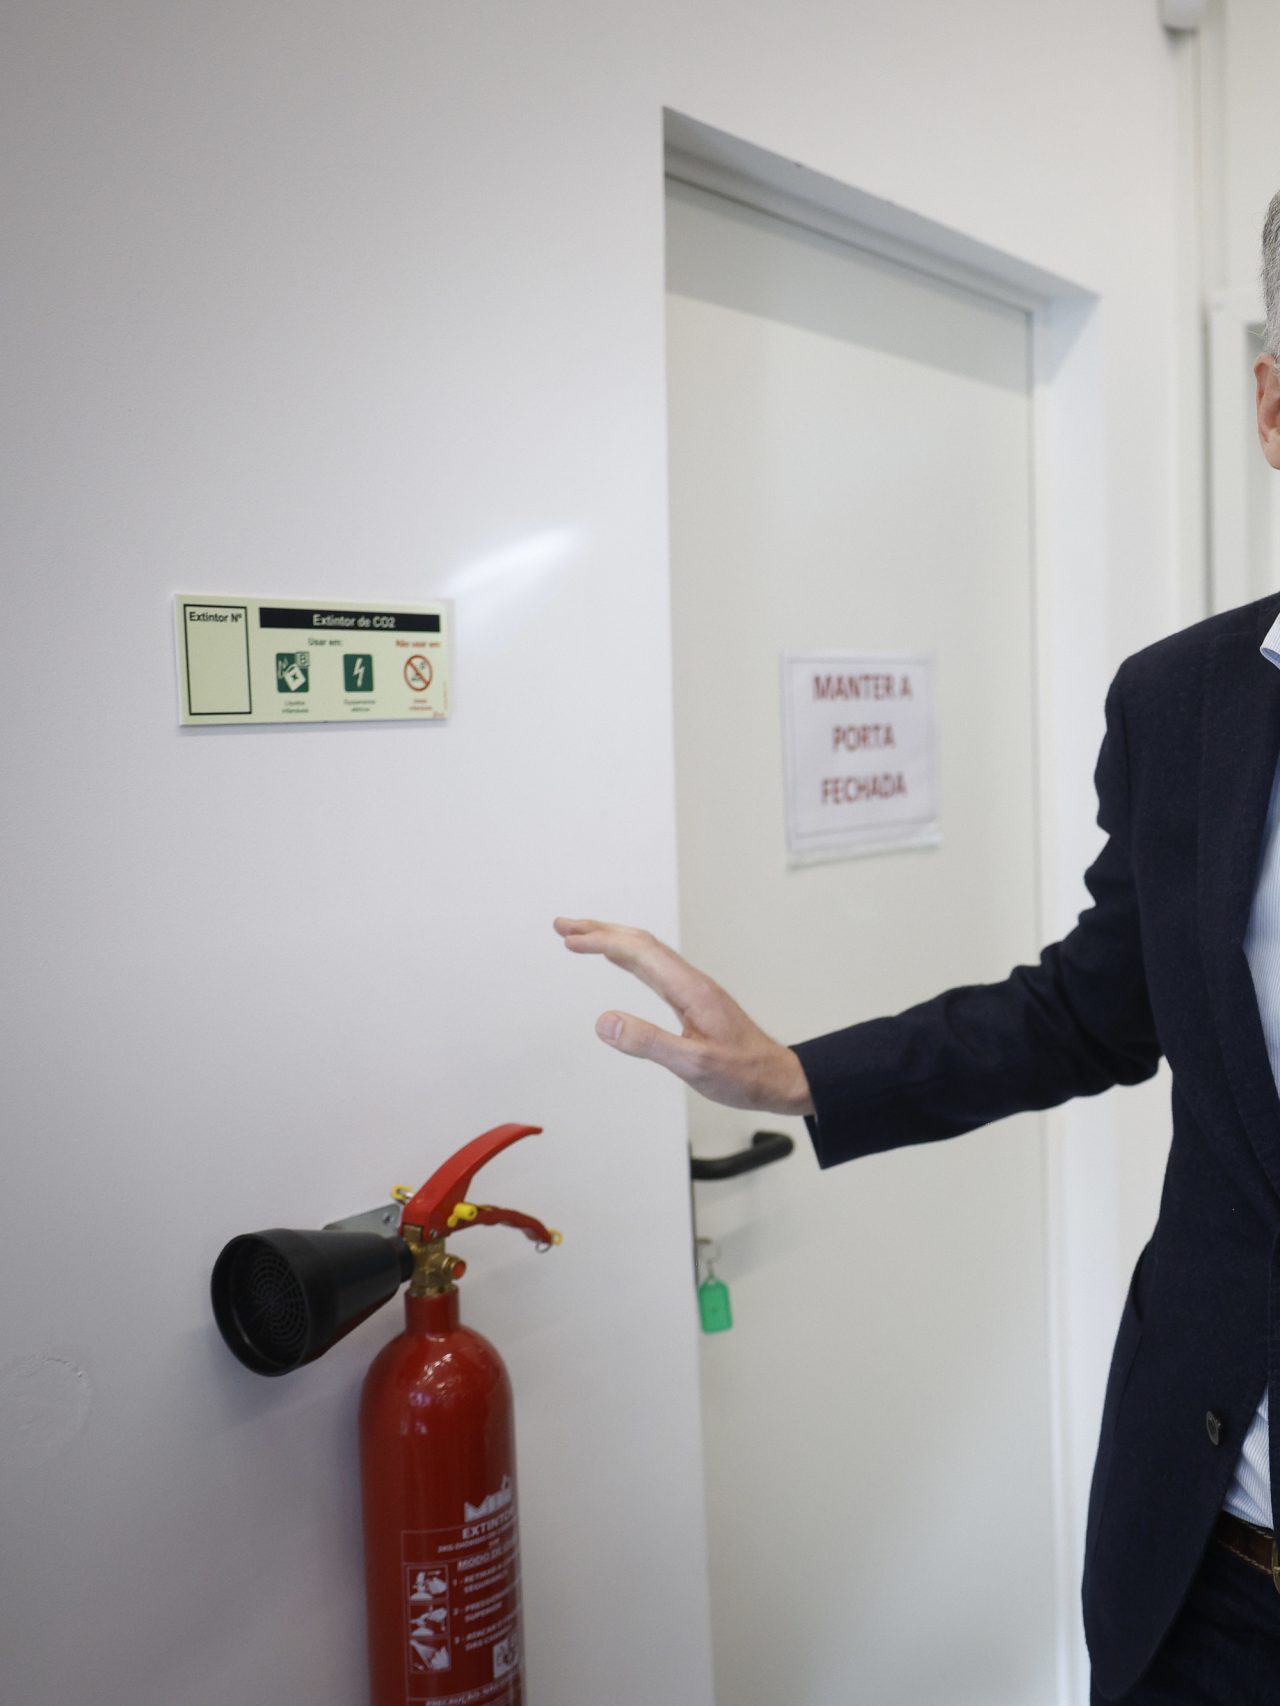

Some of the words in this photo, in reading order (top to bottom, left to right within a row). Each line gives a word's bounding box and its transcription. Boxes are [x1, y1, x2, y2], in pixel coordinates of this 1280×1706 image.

[189, 612, 228, 623] Extintor
[313, 615, 355, 627] Extintor
[357, 616, 370, 628] de
[373, 616, 396, 629] CO2
[308, 638, 326, 647] Usar
[814, 674, 895, 701] MANTER
[902, 674, 914, 699] A
[833, 724, 896, 752] PORTA
[821, 773, 908, 805] FECHADA
